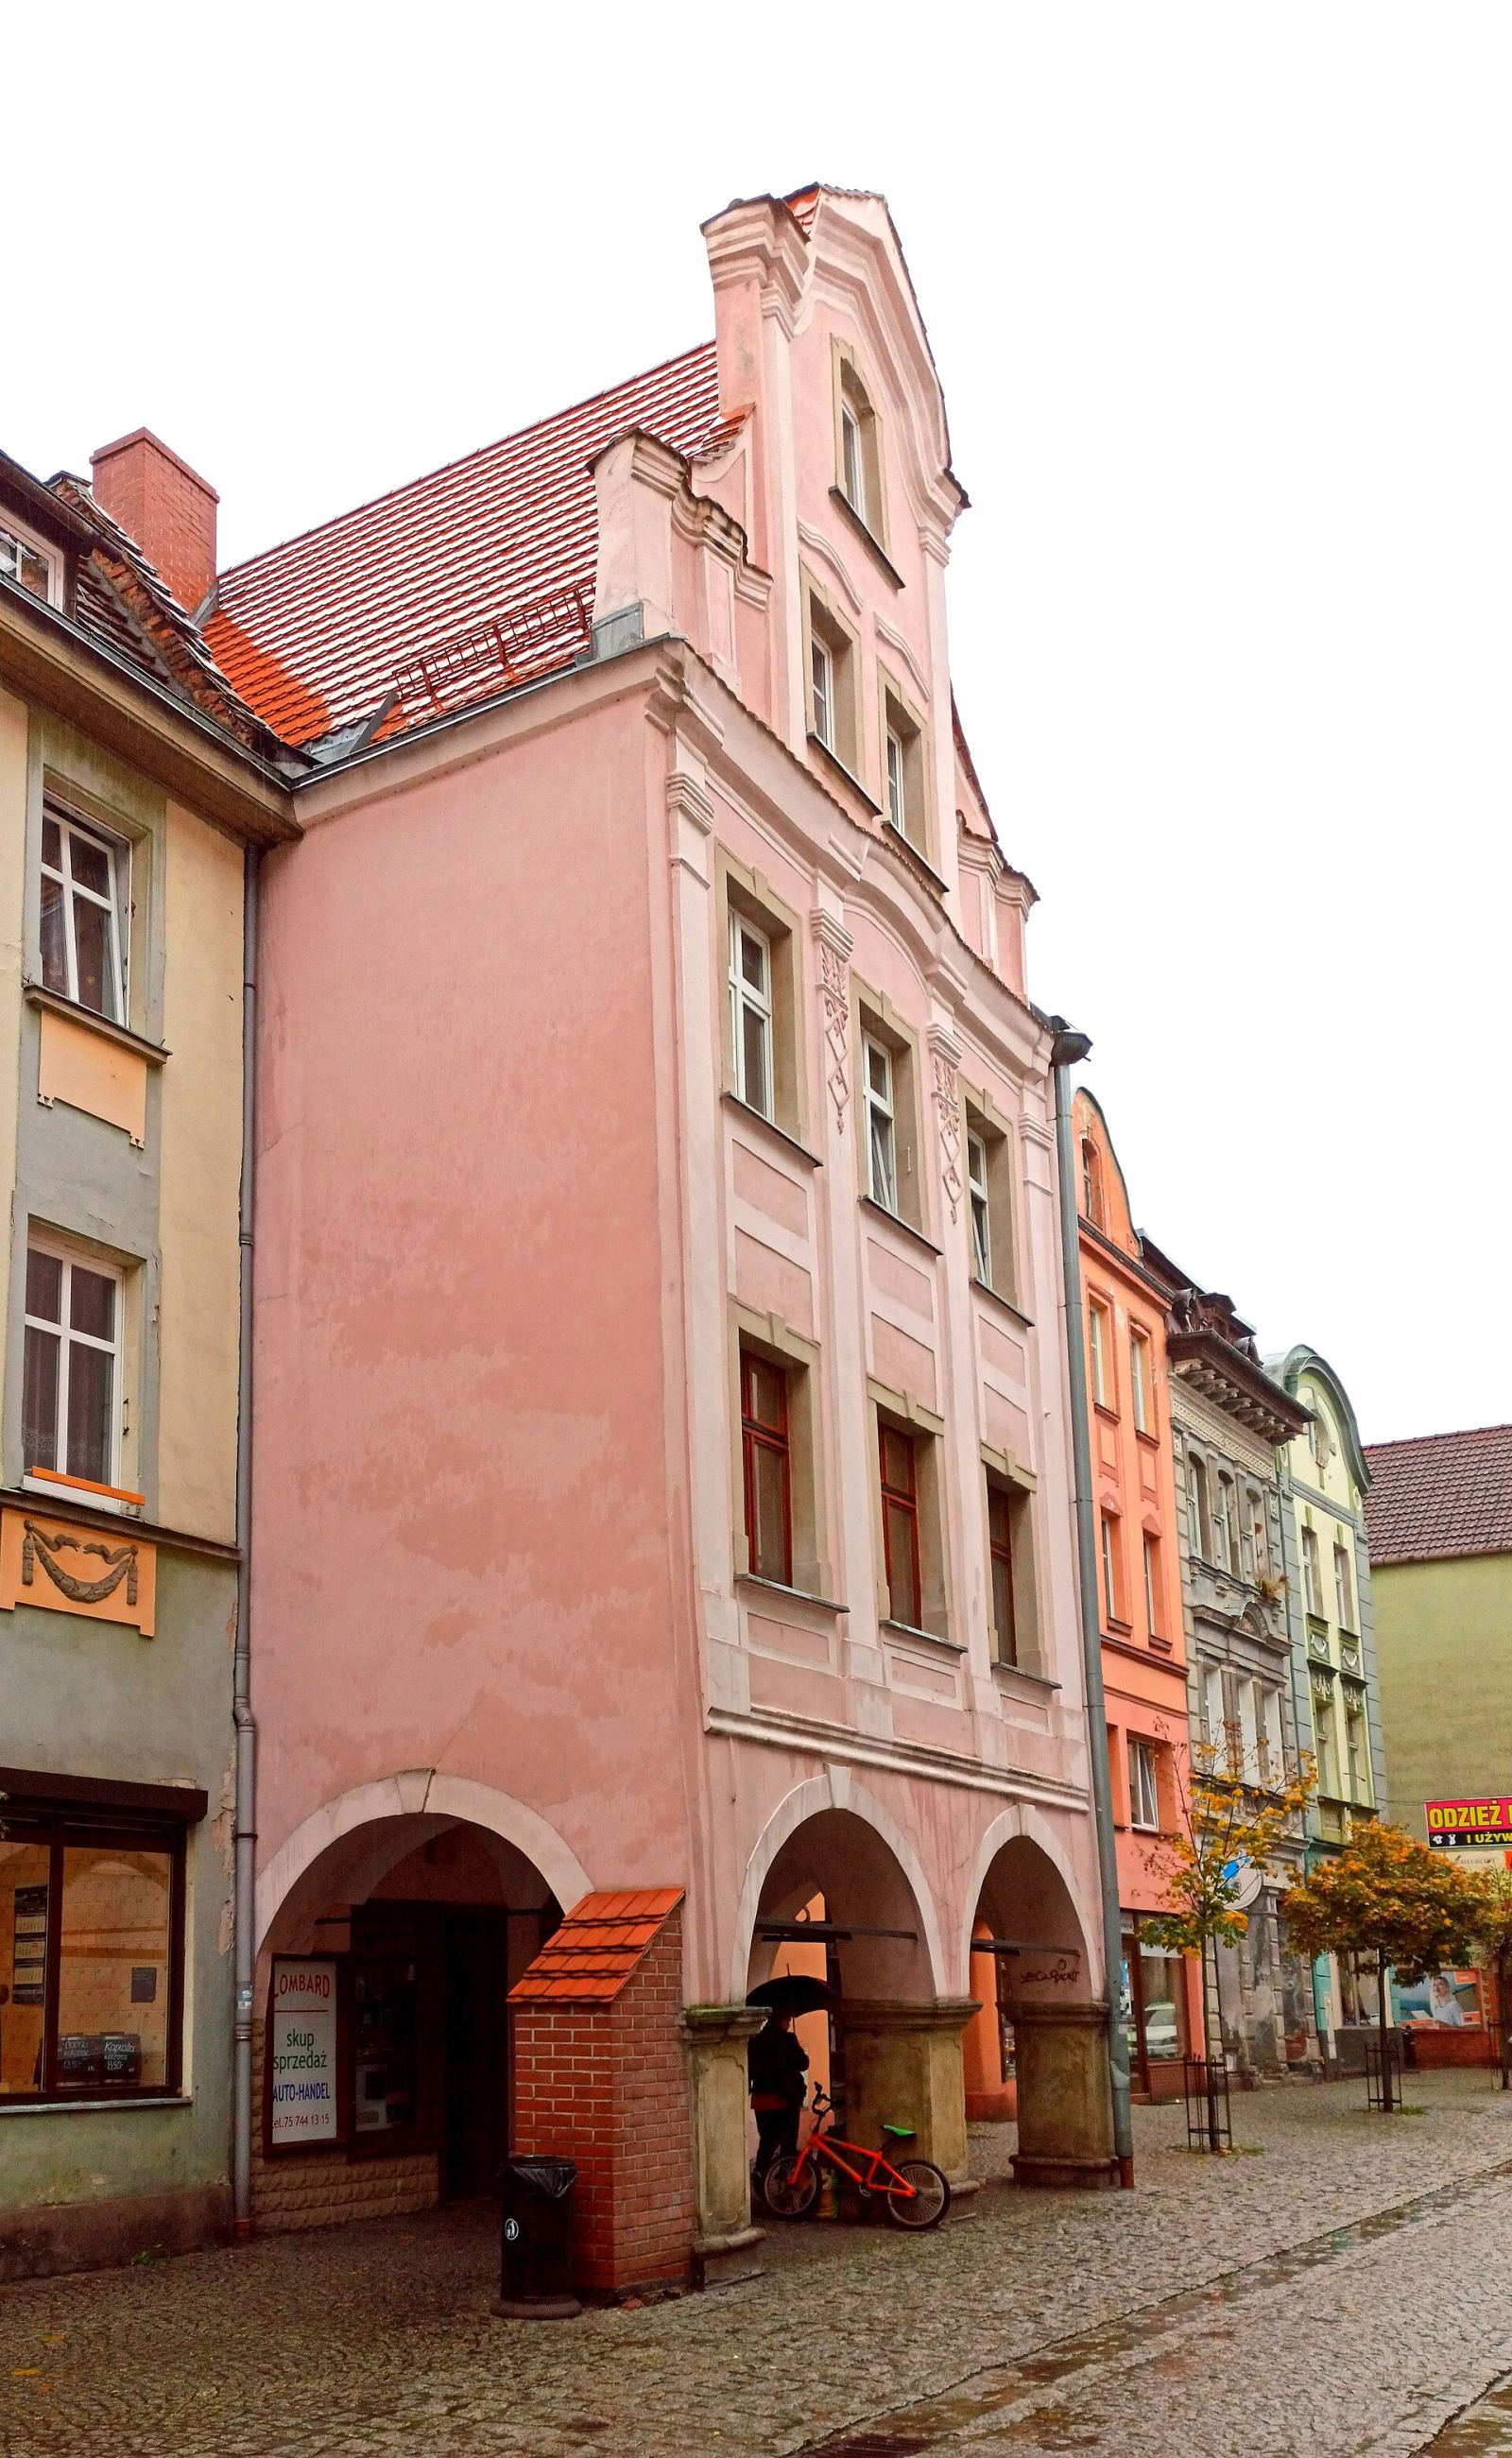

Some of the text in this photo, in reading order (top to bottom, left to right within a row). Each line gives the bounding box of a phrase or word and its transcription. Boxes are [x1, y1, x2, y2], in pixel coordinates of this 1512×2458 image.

[1429, 1800, 1503, 1829] ODZIEŻ
[286, 2028, 315, 2051] skup
[273, 2050, 327, 2073] sprzedaż
[295, 2115, 309, 2126] 744
[311, 2114, 319, 2125] 13
[321, 2113, 330, 2124] 15
